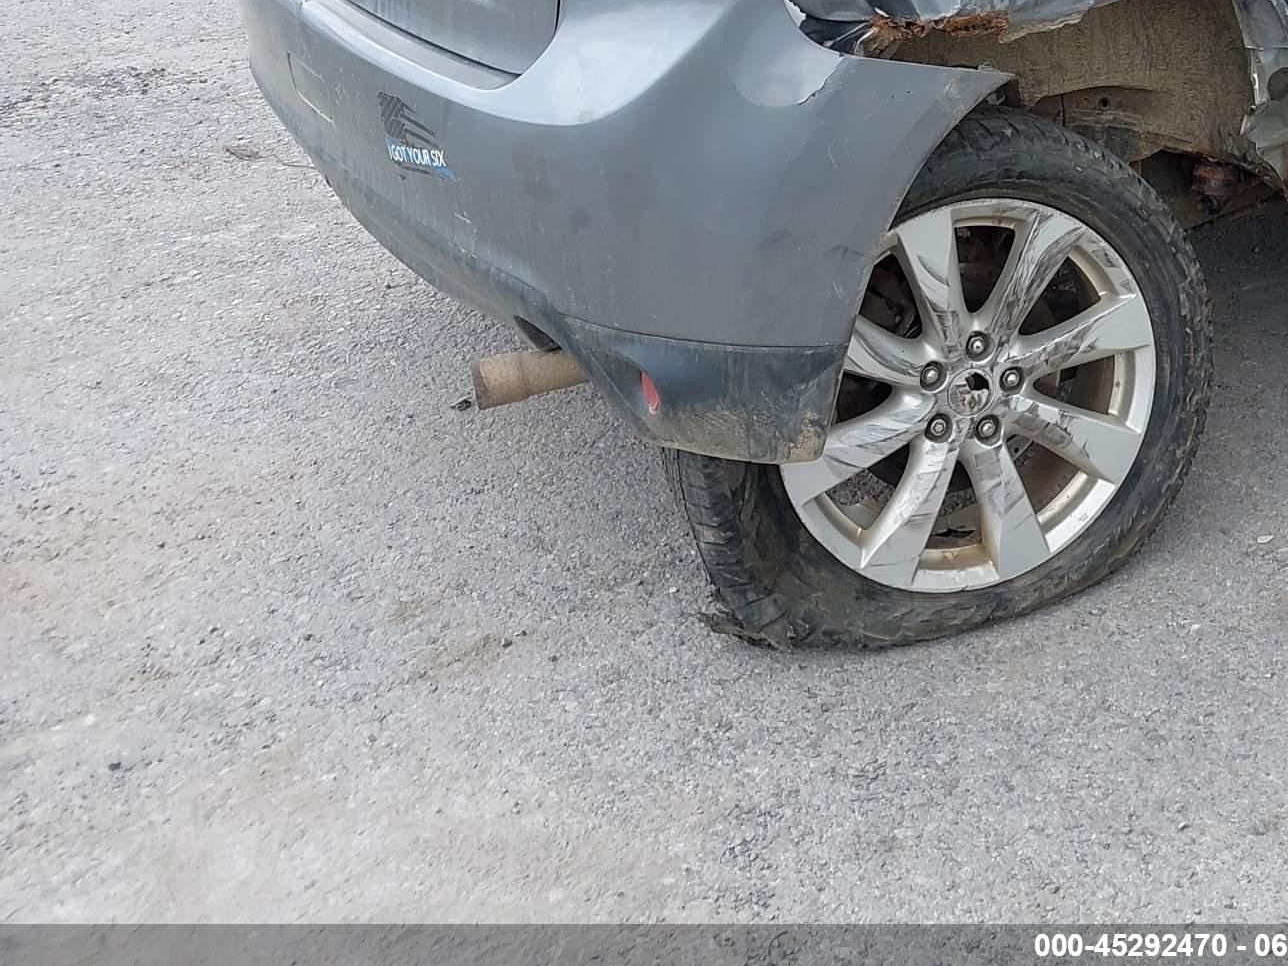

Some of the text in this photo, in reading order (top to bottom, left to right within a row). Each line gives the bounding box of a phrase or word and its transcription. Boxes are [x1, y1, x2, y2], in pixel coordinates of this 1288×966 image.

[391, 144, 407, 163] GOT
[407, 147, 431, 167] YOUR
[430, 149, 447, 168] SIX
